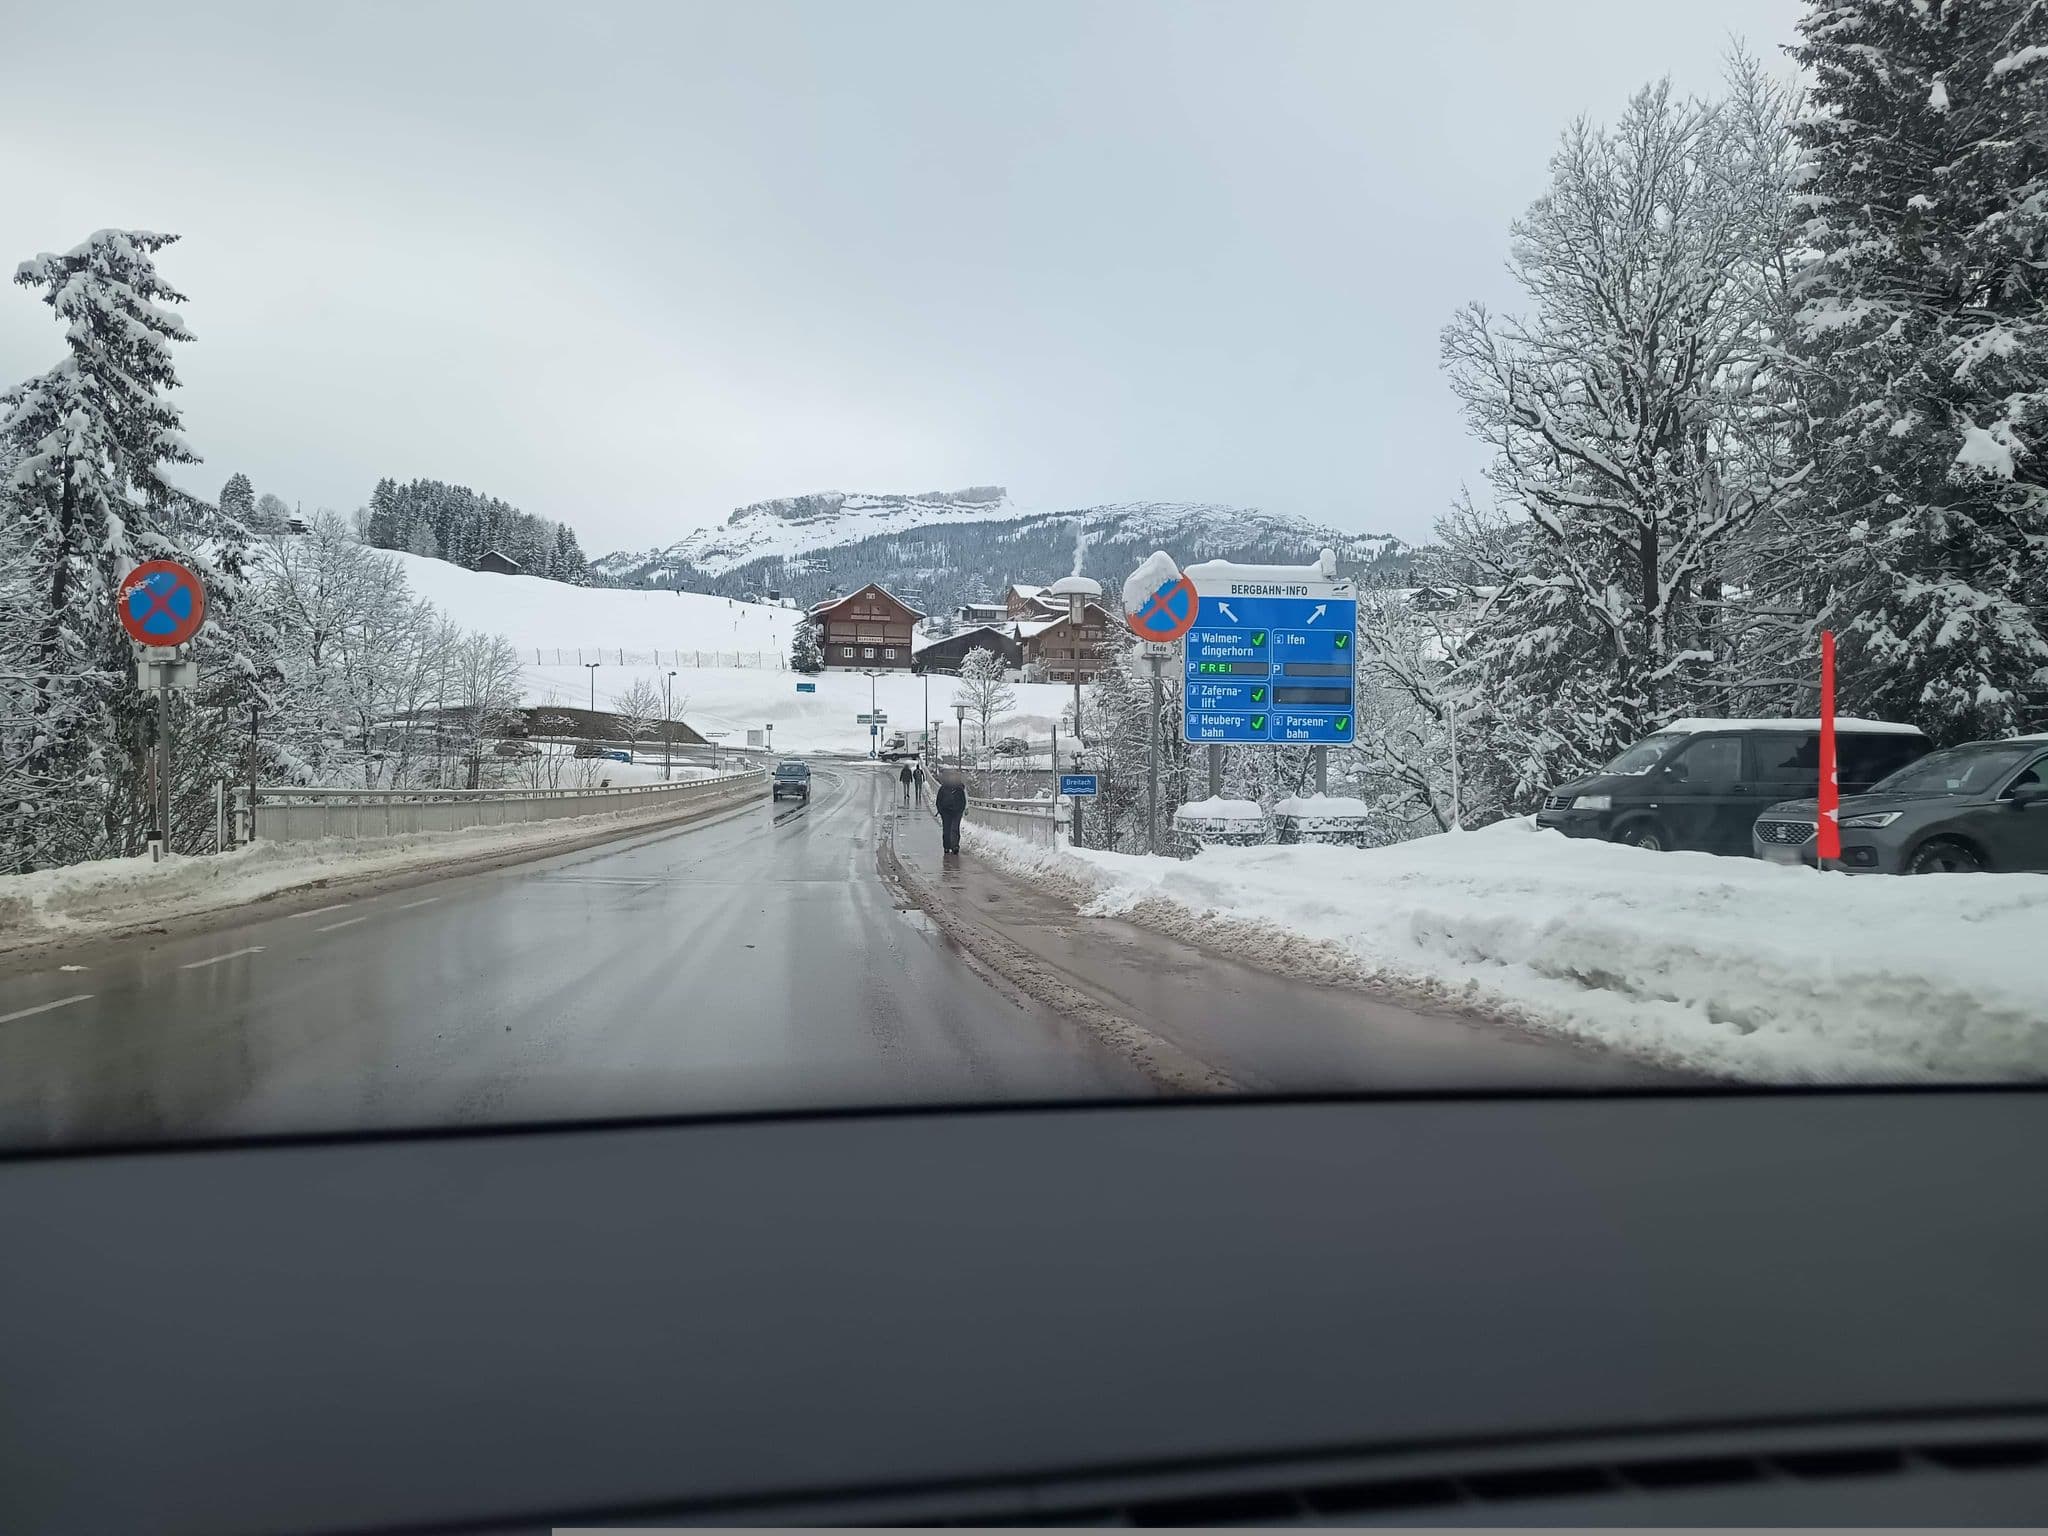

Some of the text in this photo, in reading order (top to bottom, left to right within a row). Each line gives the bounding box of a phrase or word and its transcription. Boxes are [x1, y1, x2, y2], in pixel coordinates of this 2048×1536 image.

[1231, 584, 1308, 596] BERGBAHN-INFO
[1201, 632, 1242, 643] Walmen-
[1287, 634, 1305, 645] Ifen
[1201, 646, 1254, 657] dingerhorn
[1200, 663, 1232, 672] FREI
[1201, 685, 1242, 696] Zaferna-
[1201, 697, 1216, 708] lift
[1201, 714, 1245, 727] Heuberg-
[1286, 716, 1328, 727] Parsenn-
[1201, 727, 1224, 737] bahn
[1286, 728, 1309, 739] bahn
